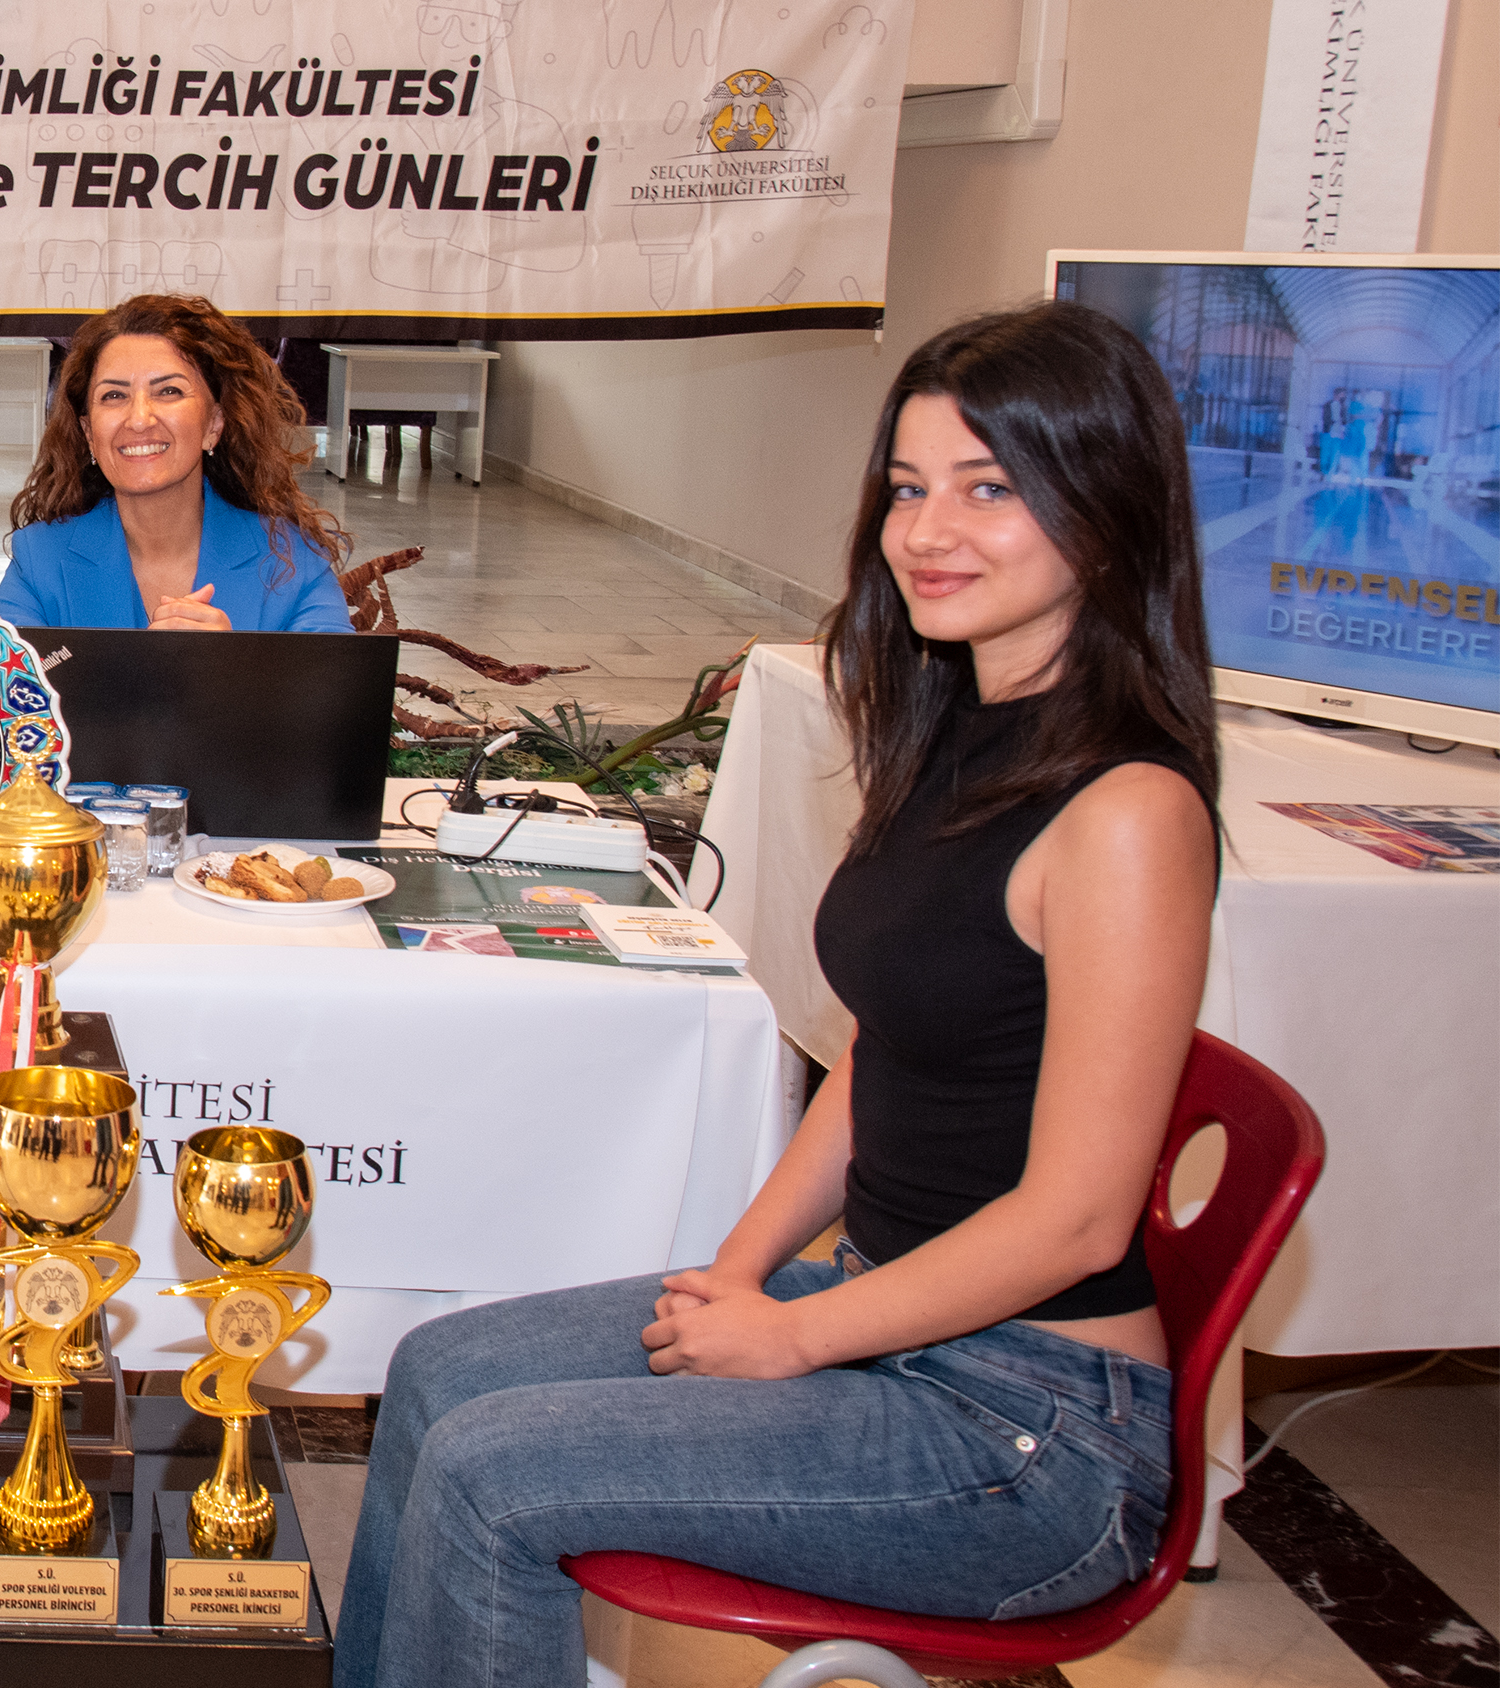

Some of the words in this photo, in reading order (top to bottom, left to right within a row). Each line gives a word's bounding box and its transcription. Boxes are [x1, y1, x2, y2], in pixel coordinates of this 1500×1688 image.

[169, 54, 482, 118] FAKÜLTESİ
[1320, 29, 1365, 251] ÜNİVERSİTE
[32, 135, 279, 211] TERCİH
[293, 135, 600, 212] GÜNLERİ
[649, 163, 714, 182] SELÇUK
[716, 154, 830, 178] ÜNİVERSİTESİ
[630, 182, 659, 203] DİŞ
[662, 177, 754, 200] HEKİMLİĞİ
[758, 172, 846, 195] FAKÜLTESİ
[40, 644, 73, 673] inkPad
[451, 863, 543, 878] Dergisi
[37, 1567, 56, 1580] S.Ü.
[227, 1570, 247, 1583] S.Ü.
[1, 1583, 25, 1594] SPOR
[26, 1582, 60, 1595] ŞENLİĞİ
[62, 1585, 107, 1596] VOLEYBOL
[172, 1586, 187, 1597] 30.
[189, 1586, 213, 1598] SPOR
[214, 1586, 248, 1599] ŞENLİĞİ
[249, 1588, 300, 1600] BASKETBOL
[50, 1598, 96, 1611] BİRİNCİSİ
[190, 1602, 240, 1613] PERSONEL
[242, 1602, 282, 1615] İKİNCİSİ
